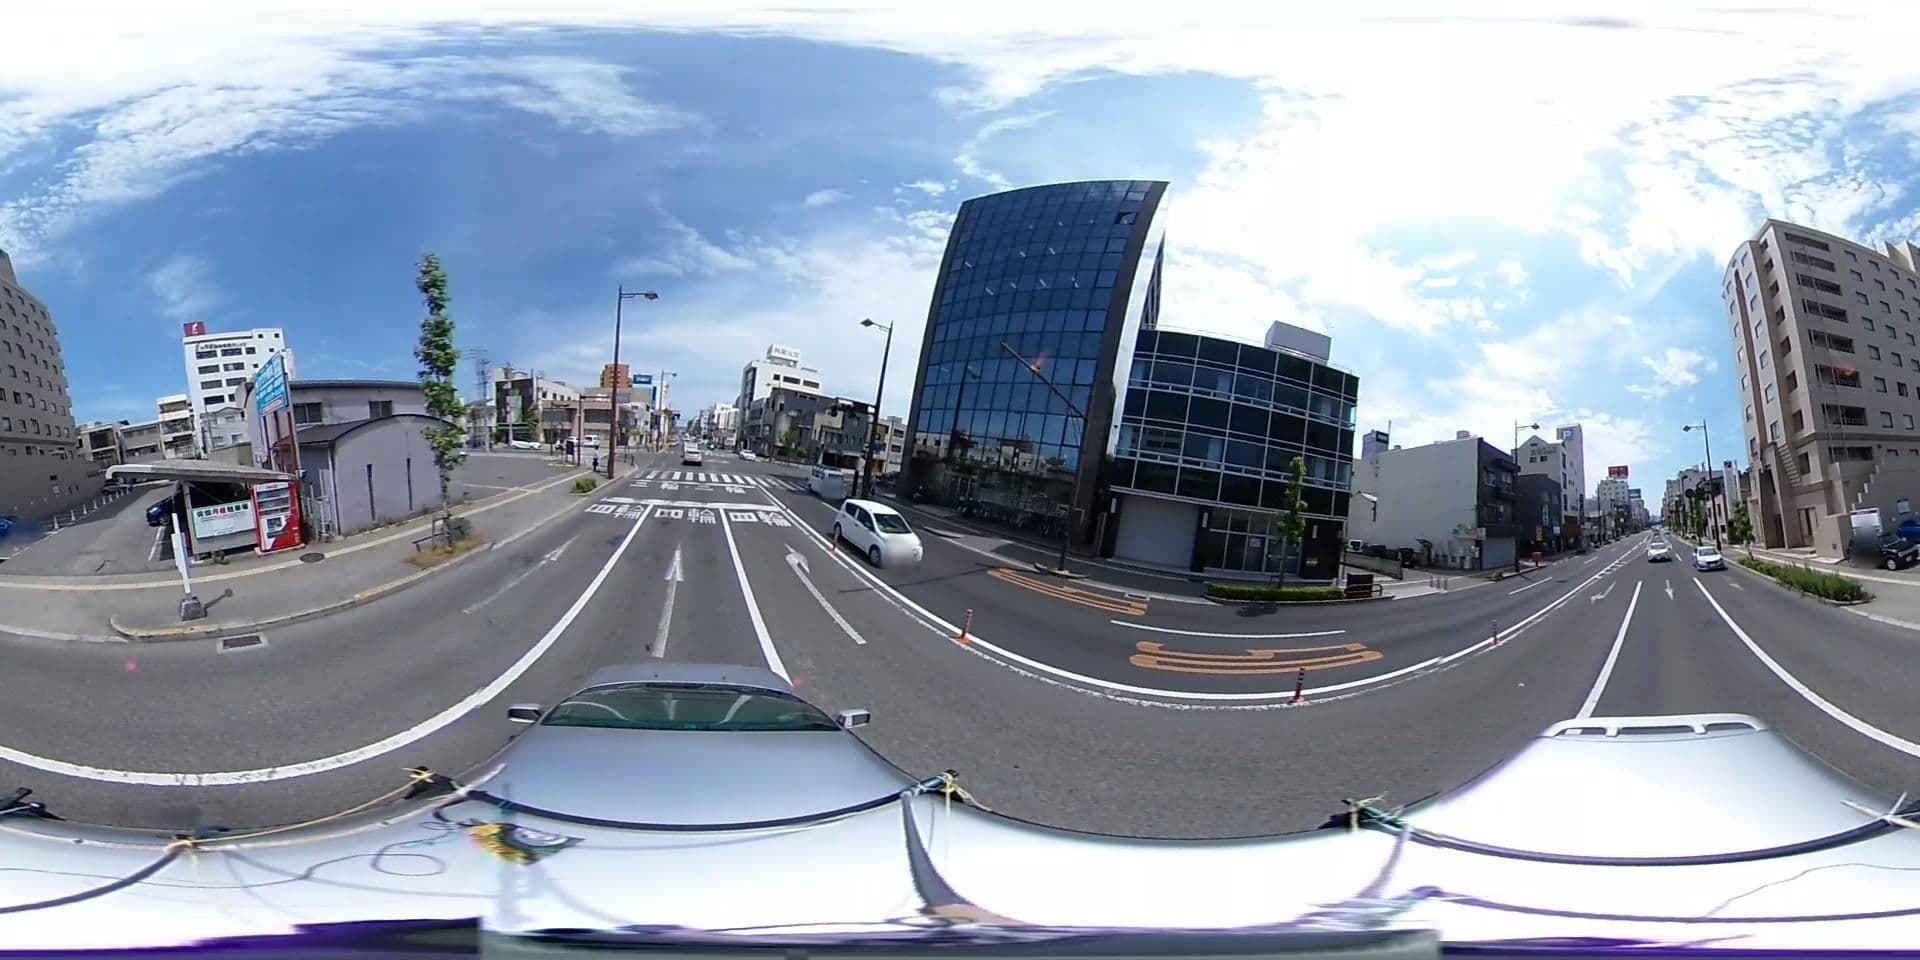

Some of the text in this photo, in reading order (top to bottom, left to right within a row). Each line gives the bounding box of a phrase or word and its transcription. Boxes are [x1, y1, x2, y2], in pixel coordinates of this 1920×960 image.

[1562, 430, 1572, 439] P
[584, 503, 645, 520] 四輪
[654, 508, 716, 525] 四輪
[728, 511, 793, 527] 四輪
